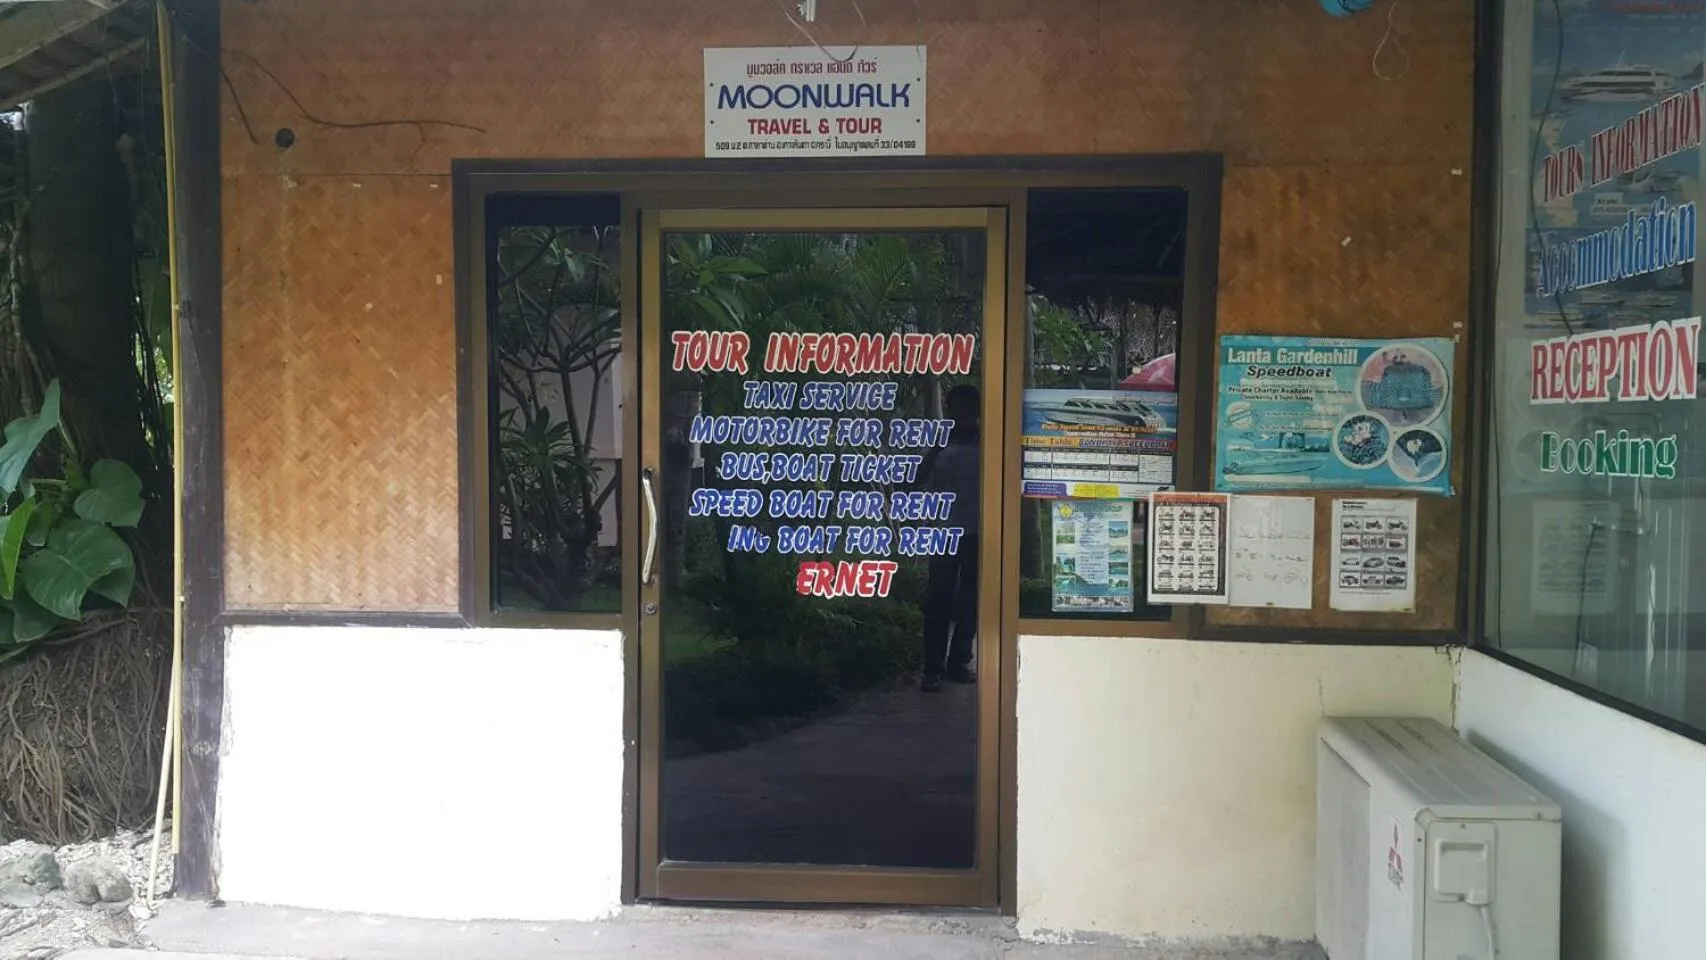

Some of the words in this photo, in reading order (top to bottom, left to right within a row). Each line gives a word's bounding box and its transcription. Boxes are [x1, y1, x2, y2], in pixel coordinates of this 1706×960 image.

[717, 83, 911, 109] MOONWALK
[748, 118, 812, 134] TRAVEL
[818, 118, 829, 134] &
[836, 117, 882, 134] TOUR
[1591, 82, 1706, 188] INFORMATION
[1537, 196, 1697, 298] Accommodation
[672, 331, 749, 375] TOUR
[764, 332, 975, 376] INFORMATION
[1227, 347, 1272, 364] Lanta
[1276, 347, 1359, 365] Gardenhill
[1530, 317, 1702, 404] RECEPTION
[1247, 365, 1333, 379] Speedboat
[743, 381, 797, 410] TAXI
[800, 381, 898, 411] SERVICE
[689, 416, 831, 447] MOTORBIKE
[836, 418, 884, 448] FOR
[889, 419, 954, 449] RENT
[720, 452, 835, 484] BUS,BOAT
[840, 455, 922, 485] TICKET
[1540, 429, 1679, 479] Booking
[689, 489, 763, 517] SPEED
[768, 490, 833, 519] BOAT
[837, 490, 885, 520] FOR
[890, 491, 956, 521] RENT
[778, 526, 842, 554] BOAT
[845, 526, 892, 556] FOR
[899, 527, 963, 556] RENT
[796, 560, 899, 599] ERNET
